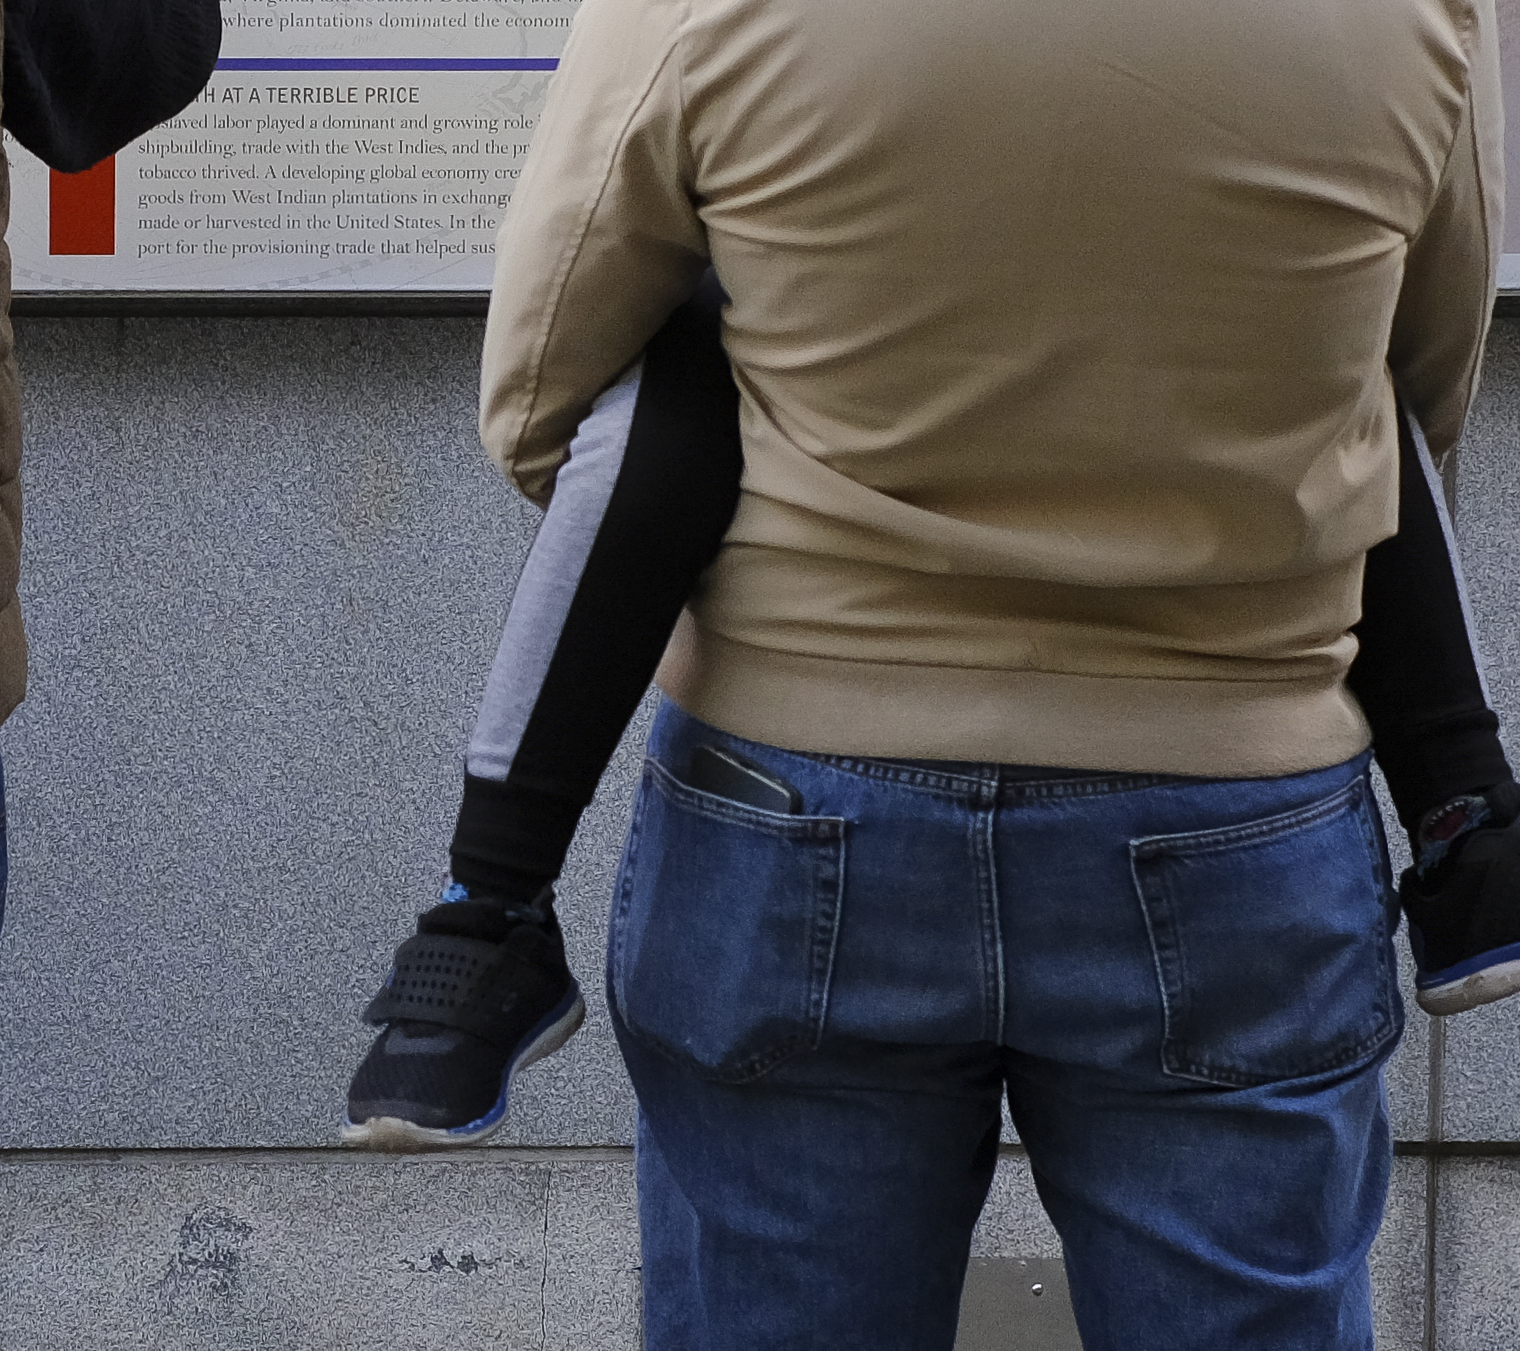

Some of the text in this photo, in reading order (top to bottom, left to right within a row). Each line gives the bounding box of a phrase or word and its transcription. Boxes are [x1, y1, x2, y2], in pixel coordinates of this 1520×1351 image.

[221, 86, 245, 104] AT
[248, 86, 262, 104] A
[265, 86, 359, 104] TERRIBLE
[364, 86, 420, 104] PRICE
[138, 163, 490, 185] tobacco thrived. A developing global economy
